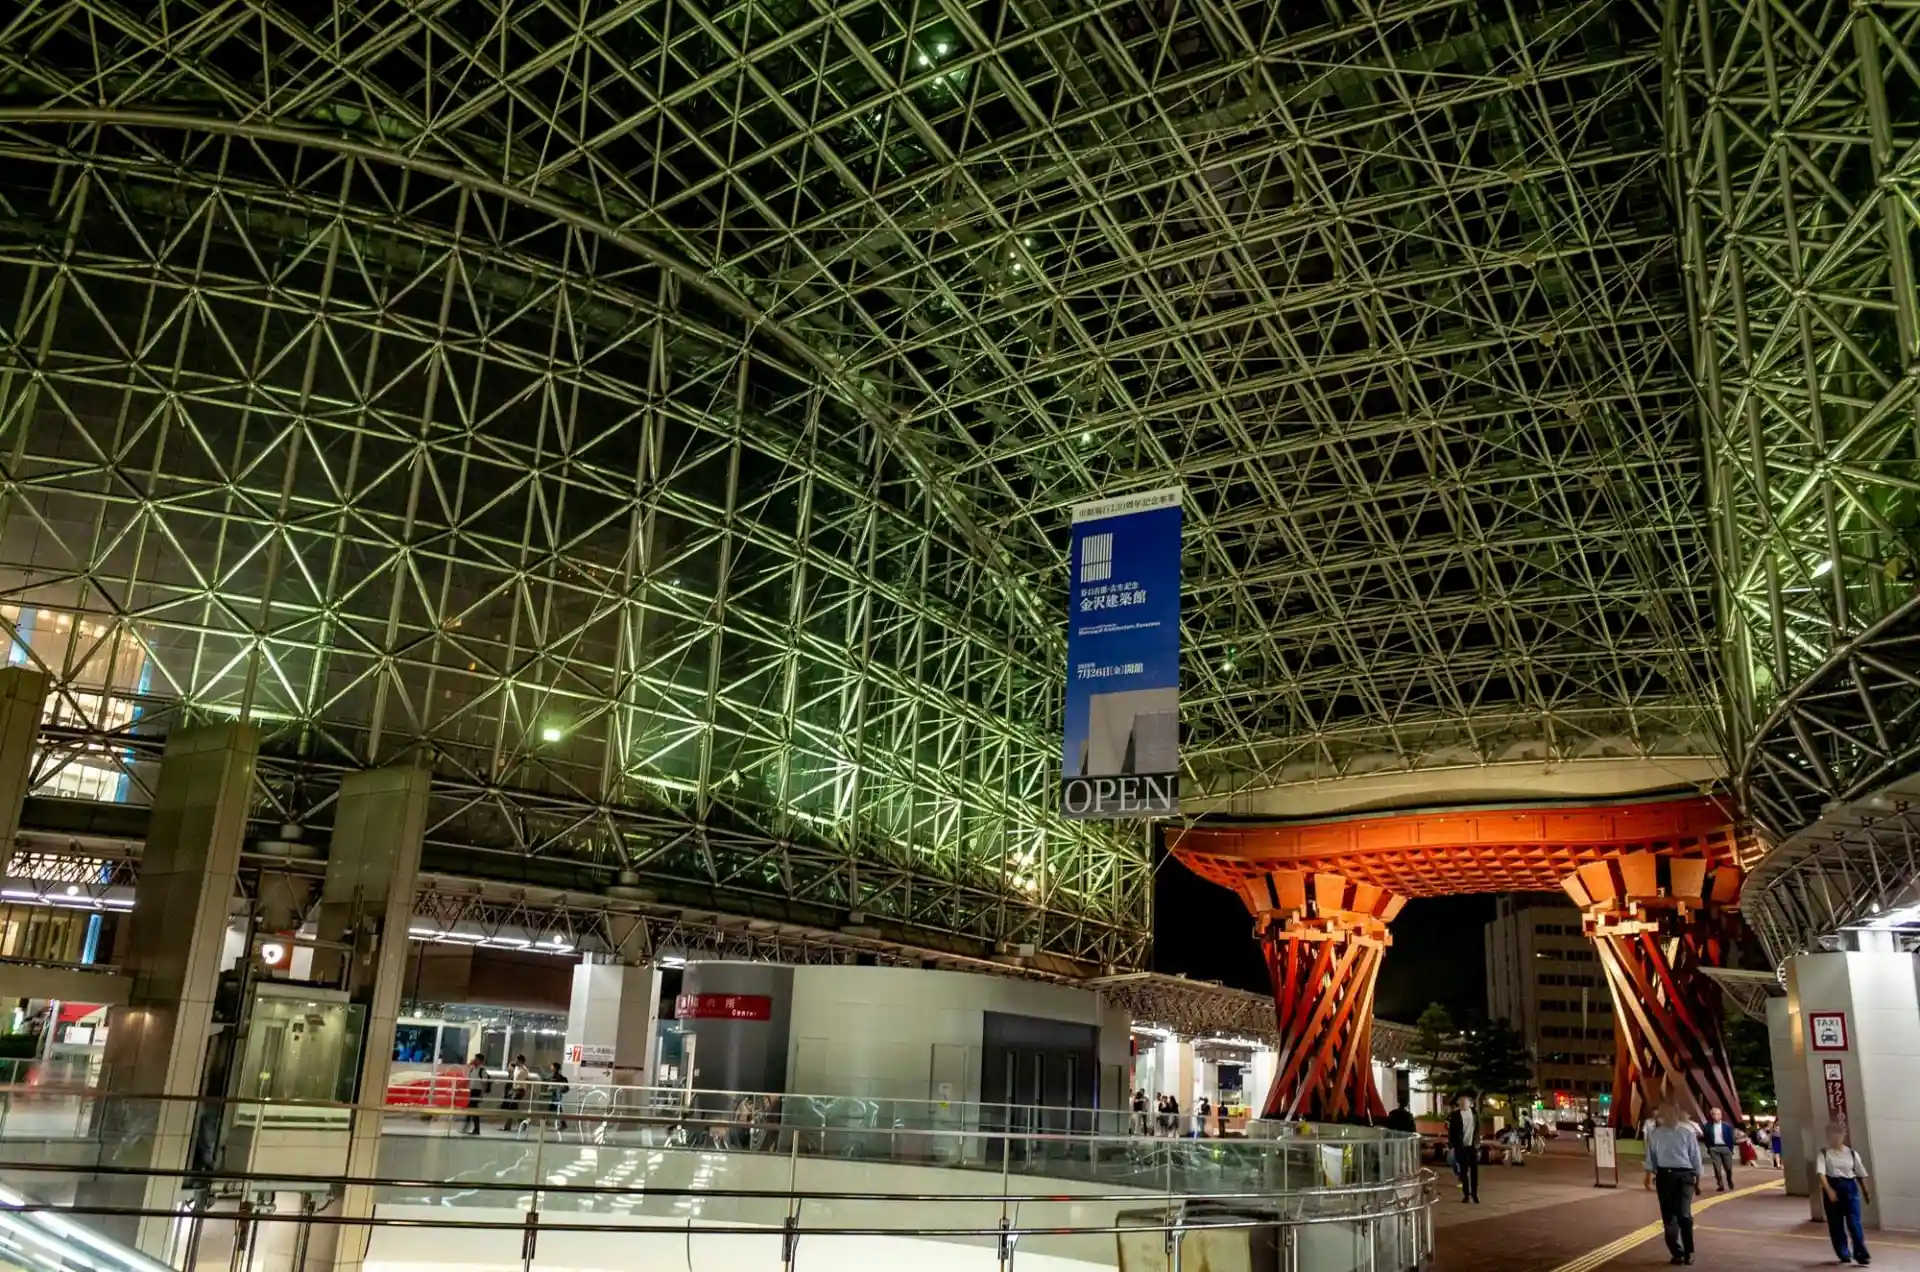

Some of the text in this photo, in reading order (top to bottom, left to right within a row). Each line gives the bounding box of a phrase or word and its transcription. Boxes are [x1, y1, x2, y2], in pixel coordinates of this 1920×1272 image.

[1079, 589, 1147, 613] 金沢建築館
[1064, 775, 1175, 814] OPEN
[1816, 1019, 1840, 1027] TAXI
